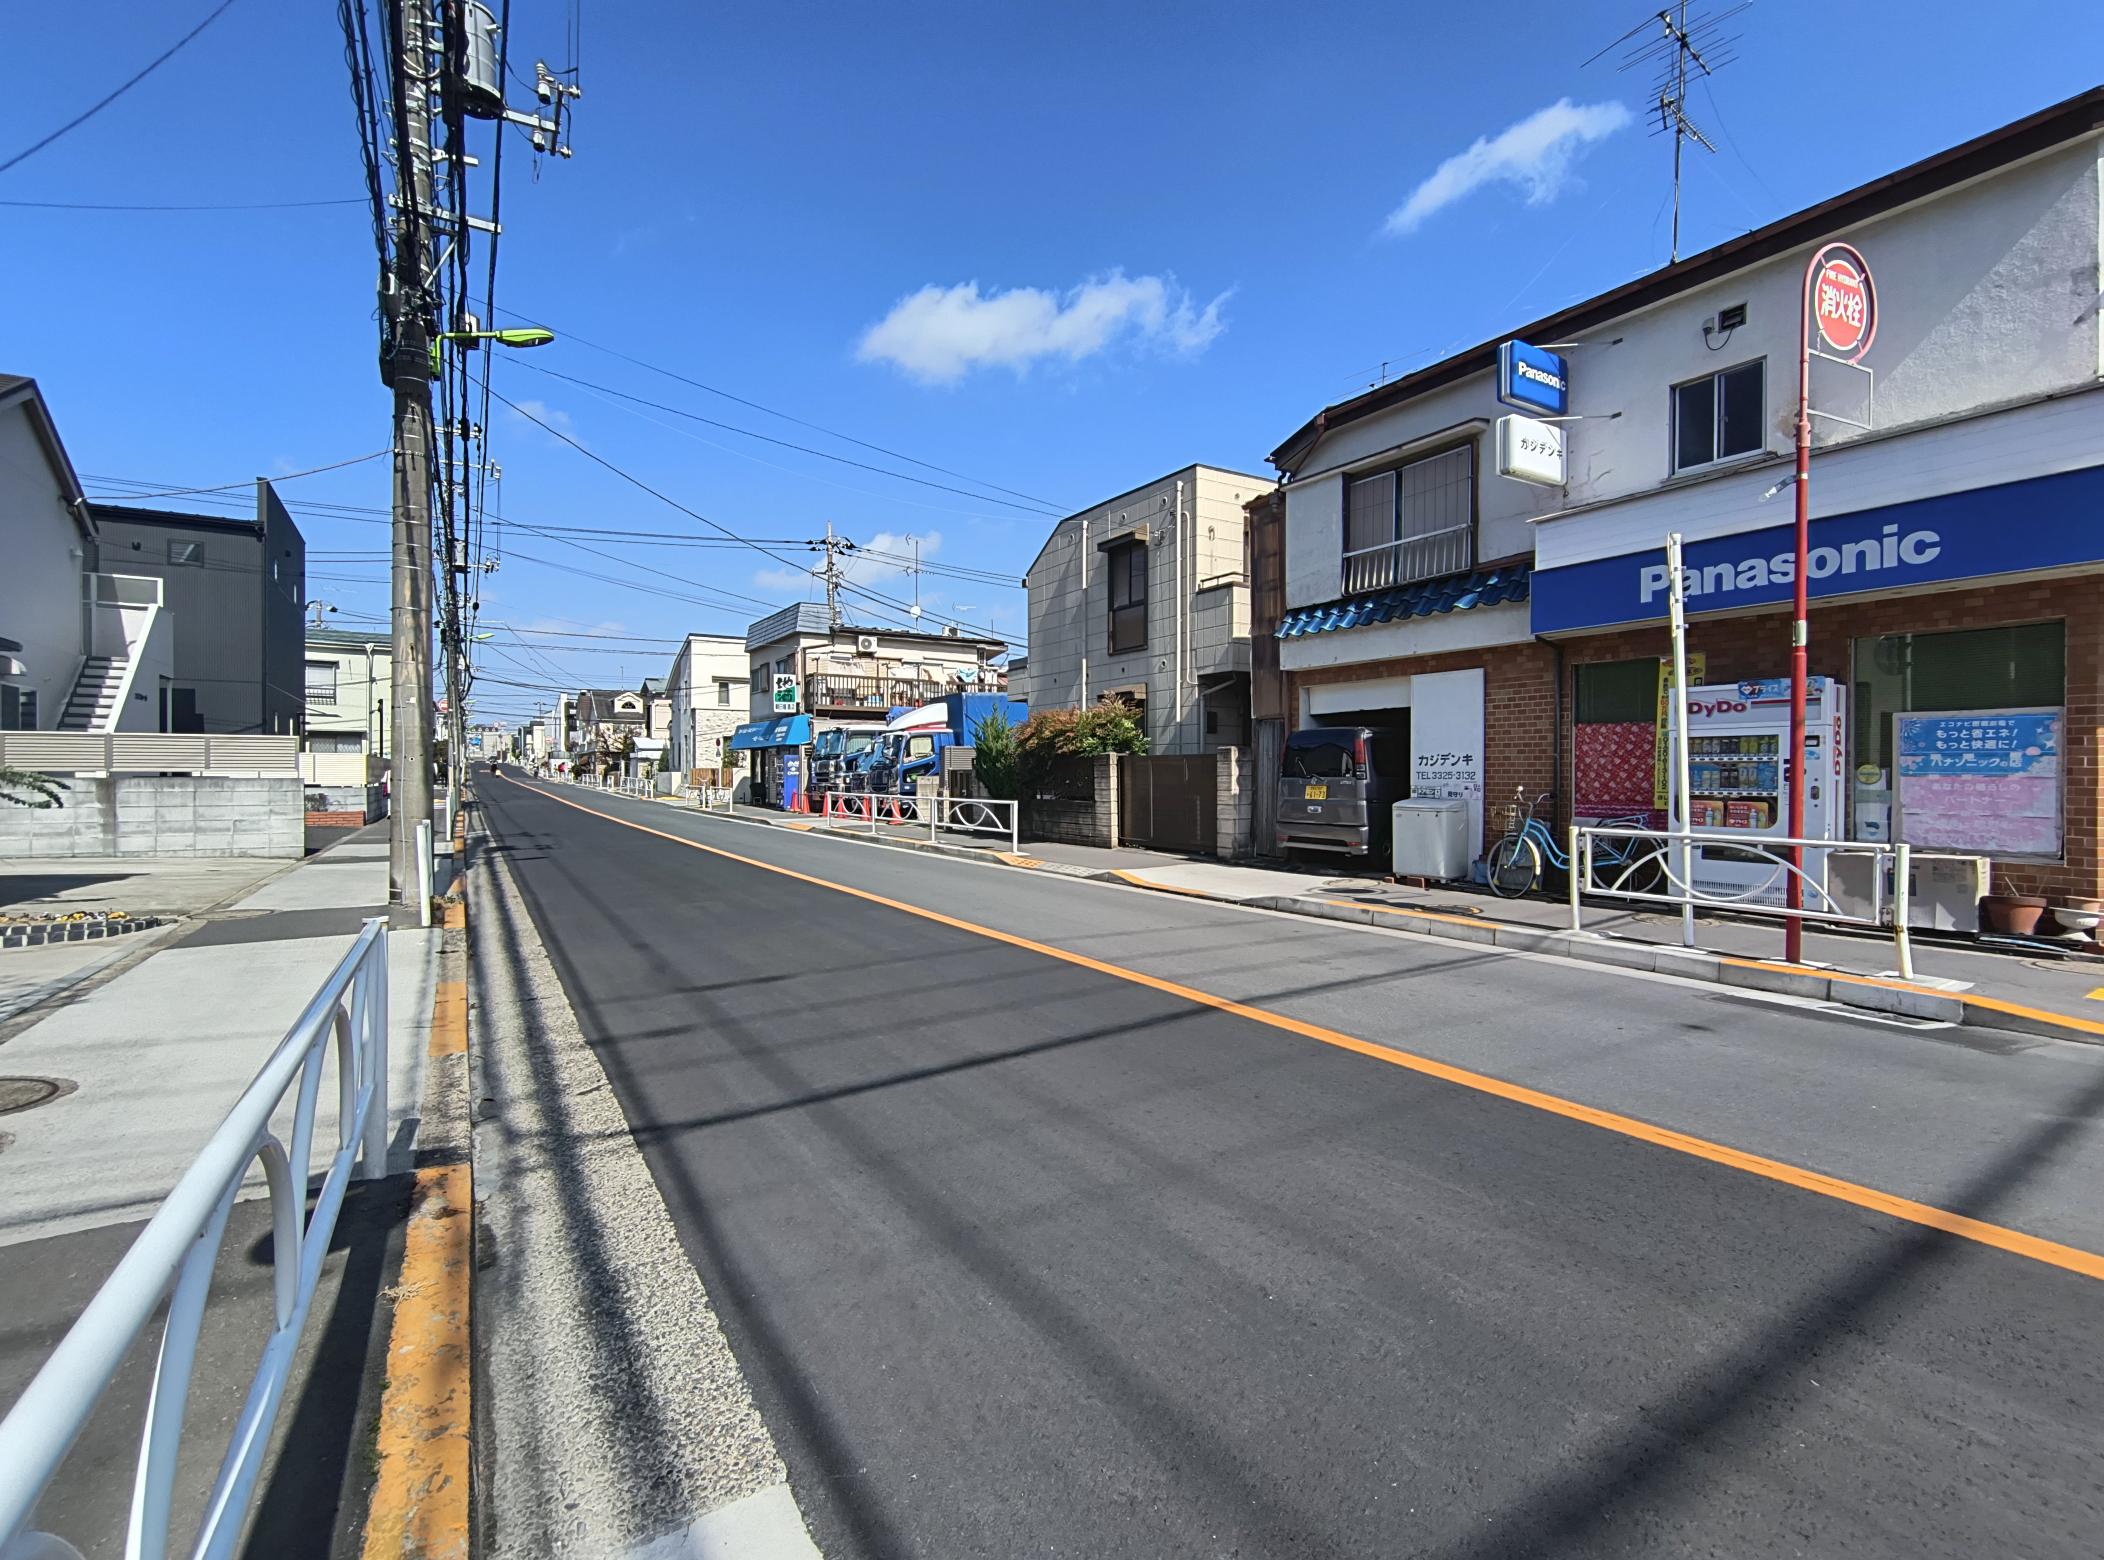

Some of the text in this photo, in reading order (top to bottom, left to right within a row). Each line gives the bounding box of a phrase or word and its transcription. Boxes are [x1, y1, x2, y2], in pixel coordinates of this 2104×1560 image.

[1820, 283, 1862, 328] 消火栓
[1518, 360, 1567, 391] Panasonic
[1520, 436, 1564, 461] カジデンキ
[1640, 523, 1941, 603] Panasonic
[1688, 700, 1747, 718] DyDo
[1418, 752, 1474, 767] カジデンキ
[1833, 715, 1843, 776] DyDo
